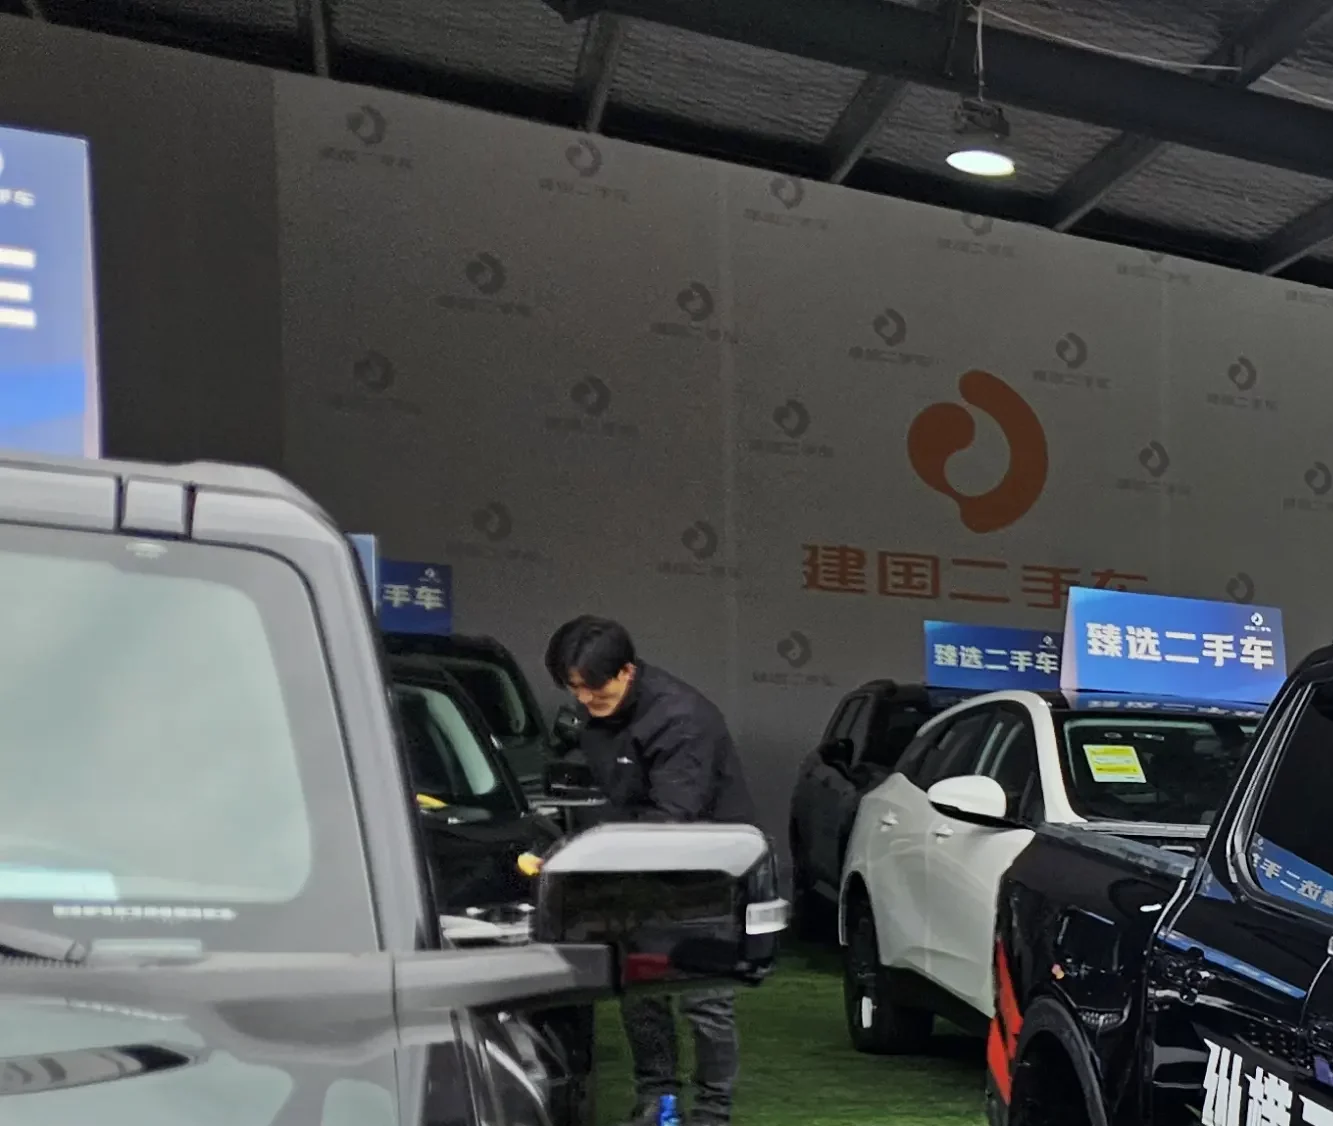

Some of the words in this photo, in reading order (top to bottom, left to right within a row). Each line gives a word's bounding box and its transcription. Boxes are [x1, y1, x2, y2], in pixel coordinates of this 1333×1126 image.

[933, 643, 1059, 674] 臻选二手车
[1085, 621, 1274, 670] 臻选二手车
